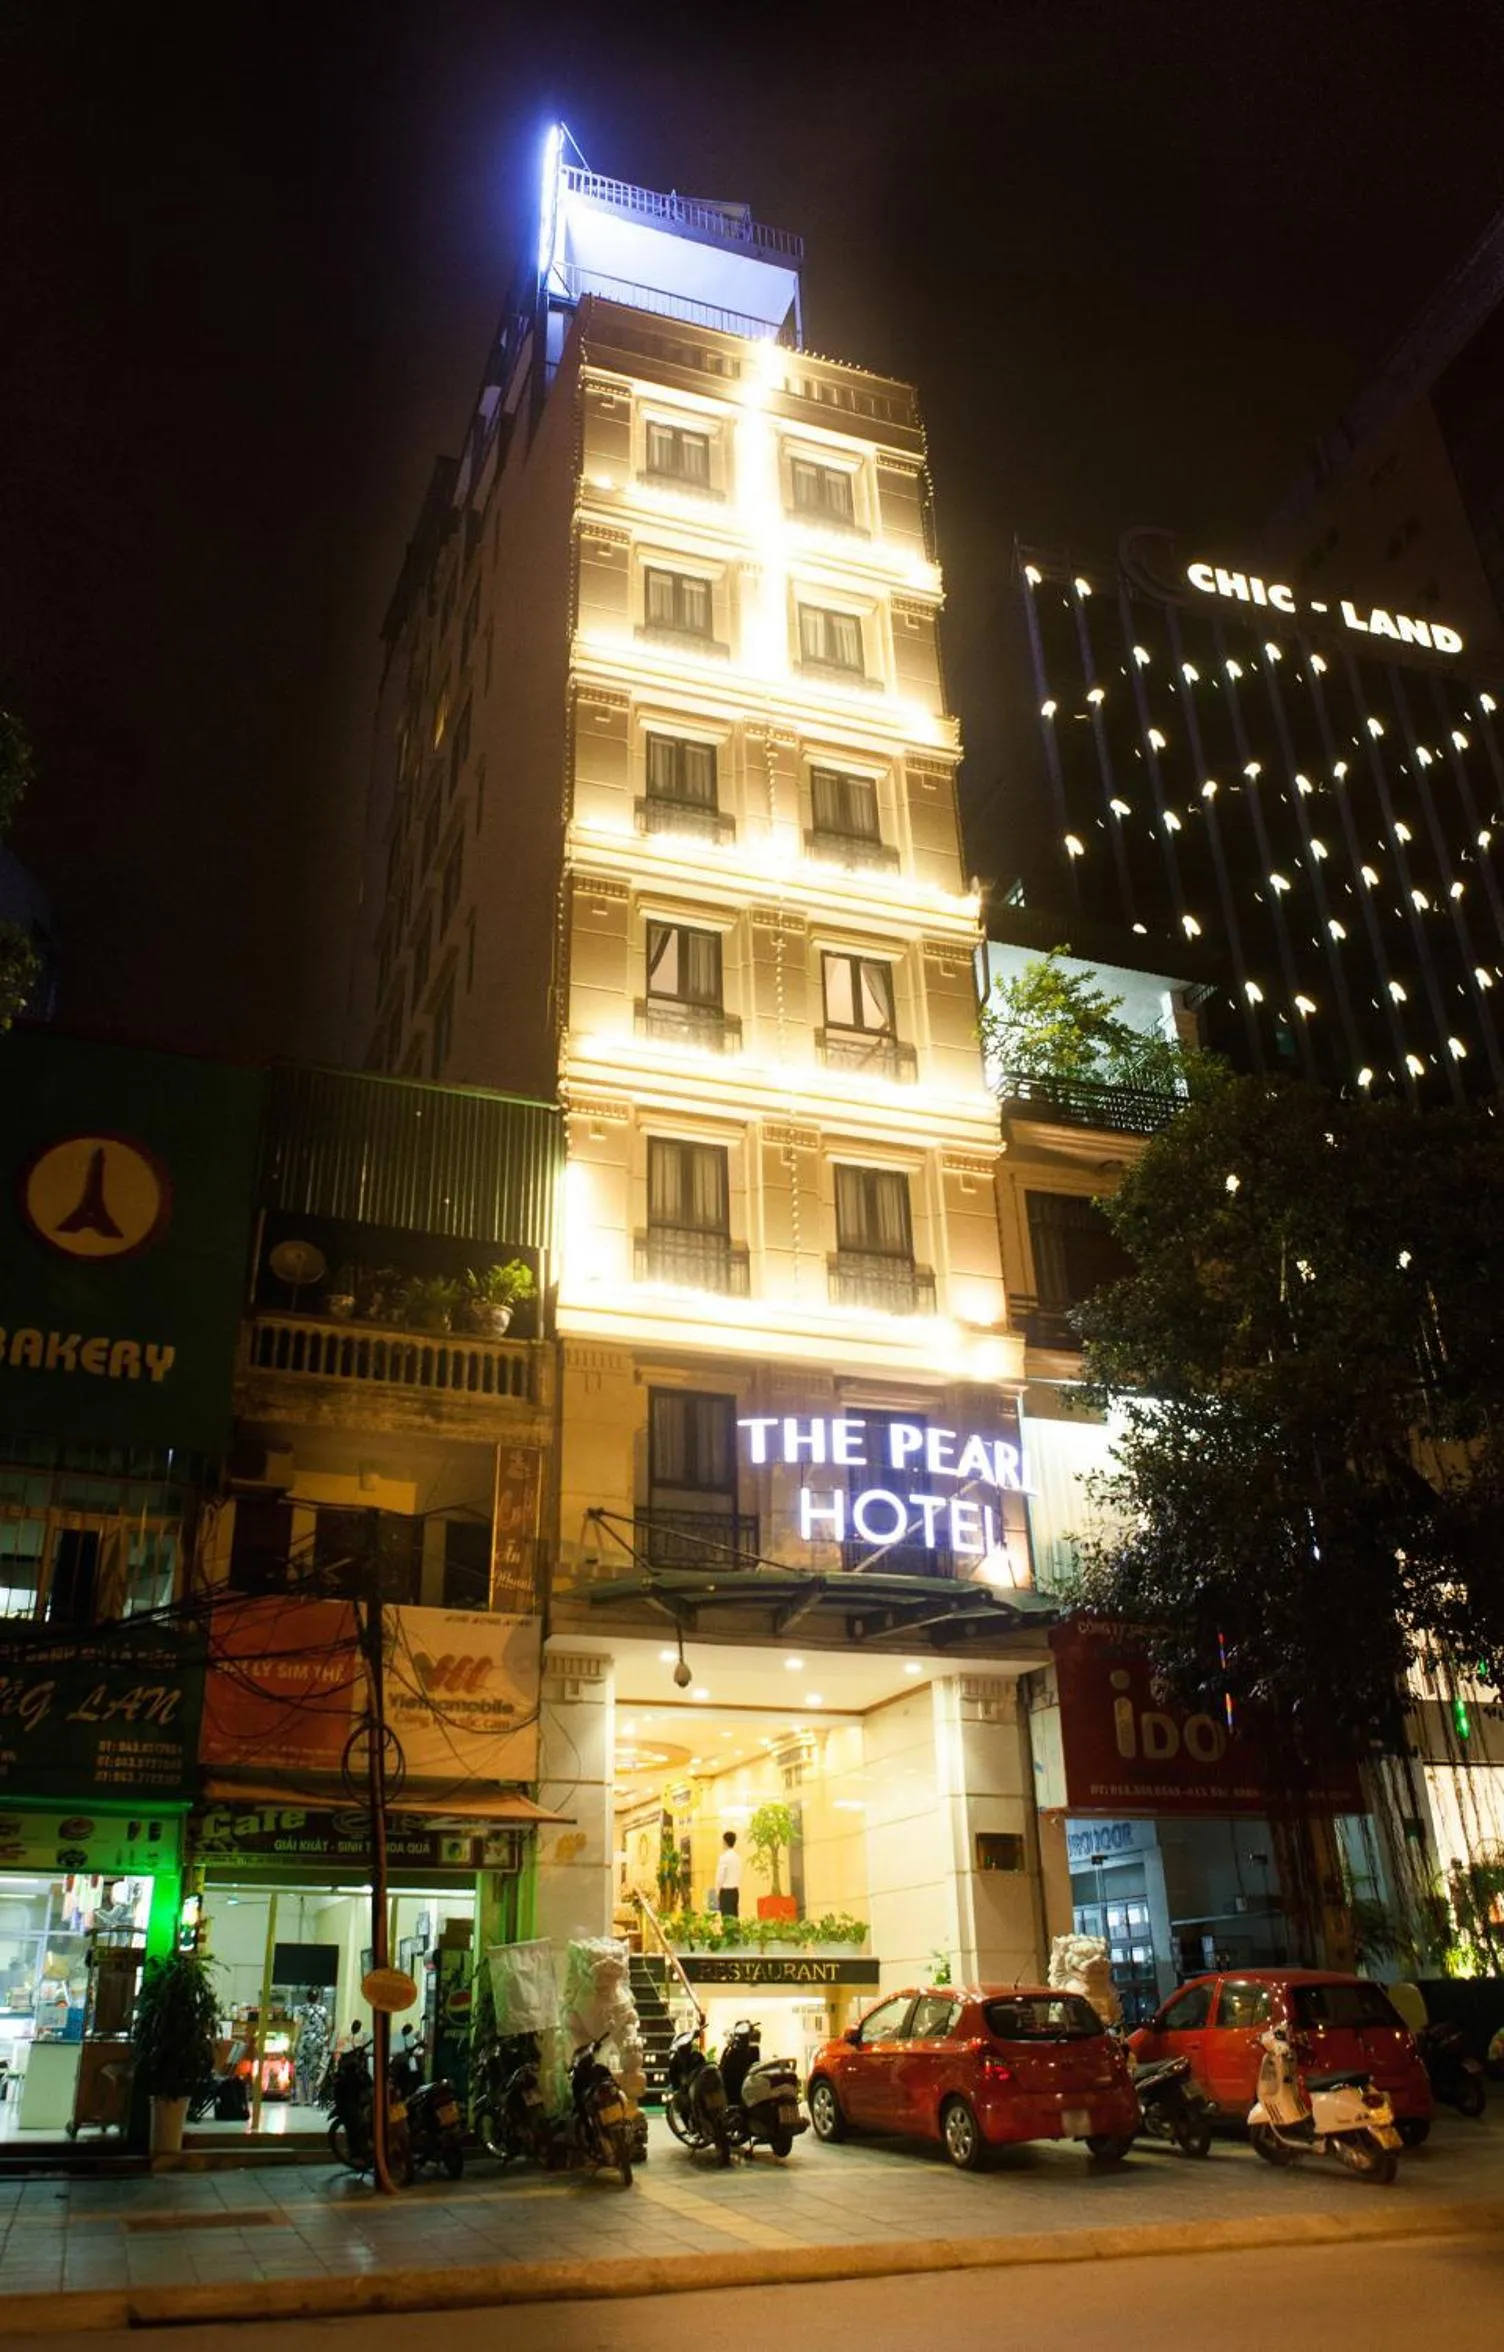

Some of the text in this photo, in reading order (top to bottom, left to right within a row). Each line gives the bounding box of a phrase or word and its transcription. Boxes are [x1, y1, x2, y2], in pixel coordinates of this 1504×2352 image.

[1186, 562, 1297, 615] CHIC
[1340, 600, 1464, 655] LAND
[0, 1326, 176, 1383] AKERY
[737, 1418, 1040, 1496] THE PEARL
[800, 1486, 1006, 1557] HOTEL
[276, 1662, 308, 1680] SIM
[65, 1684, 182, 1726] LAN
[697, 1961, 841, 1982] RESTAURANT
